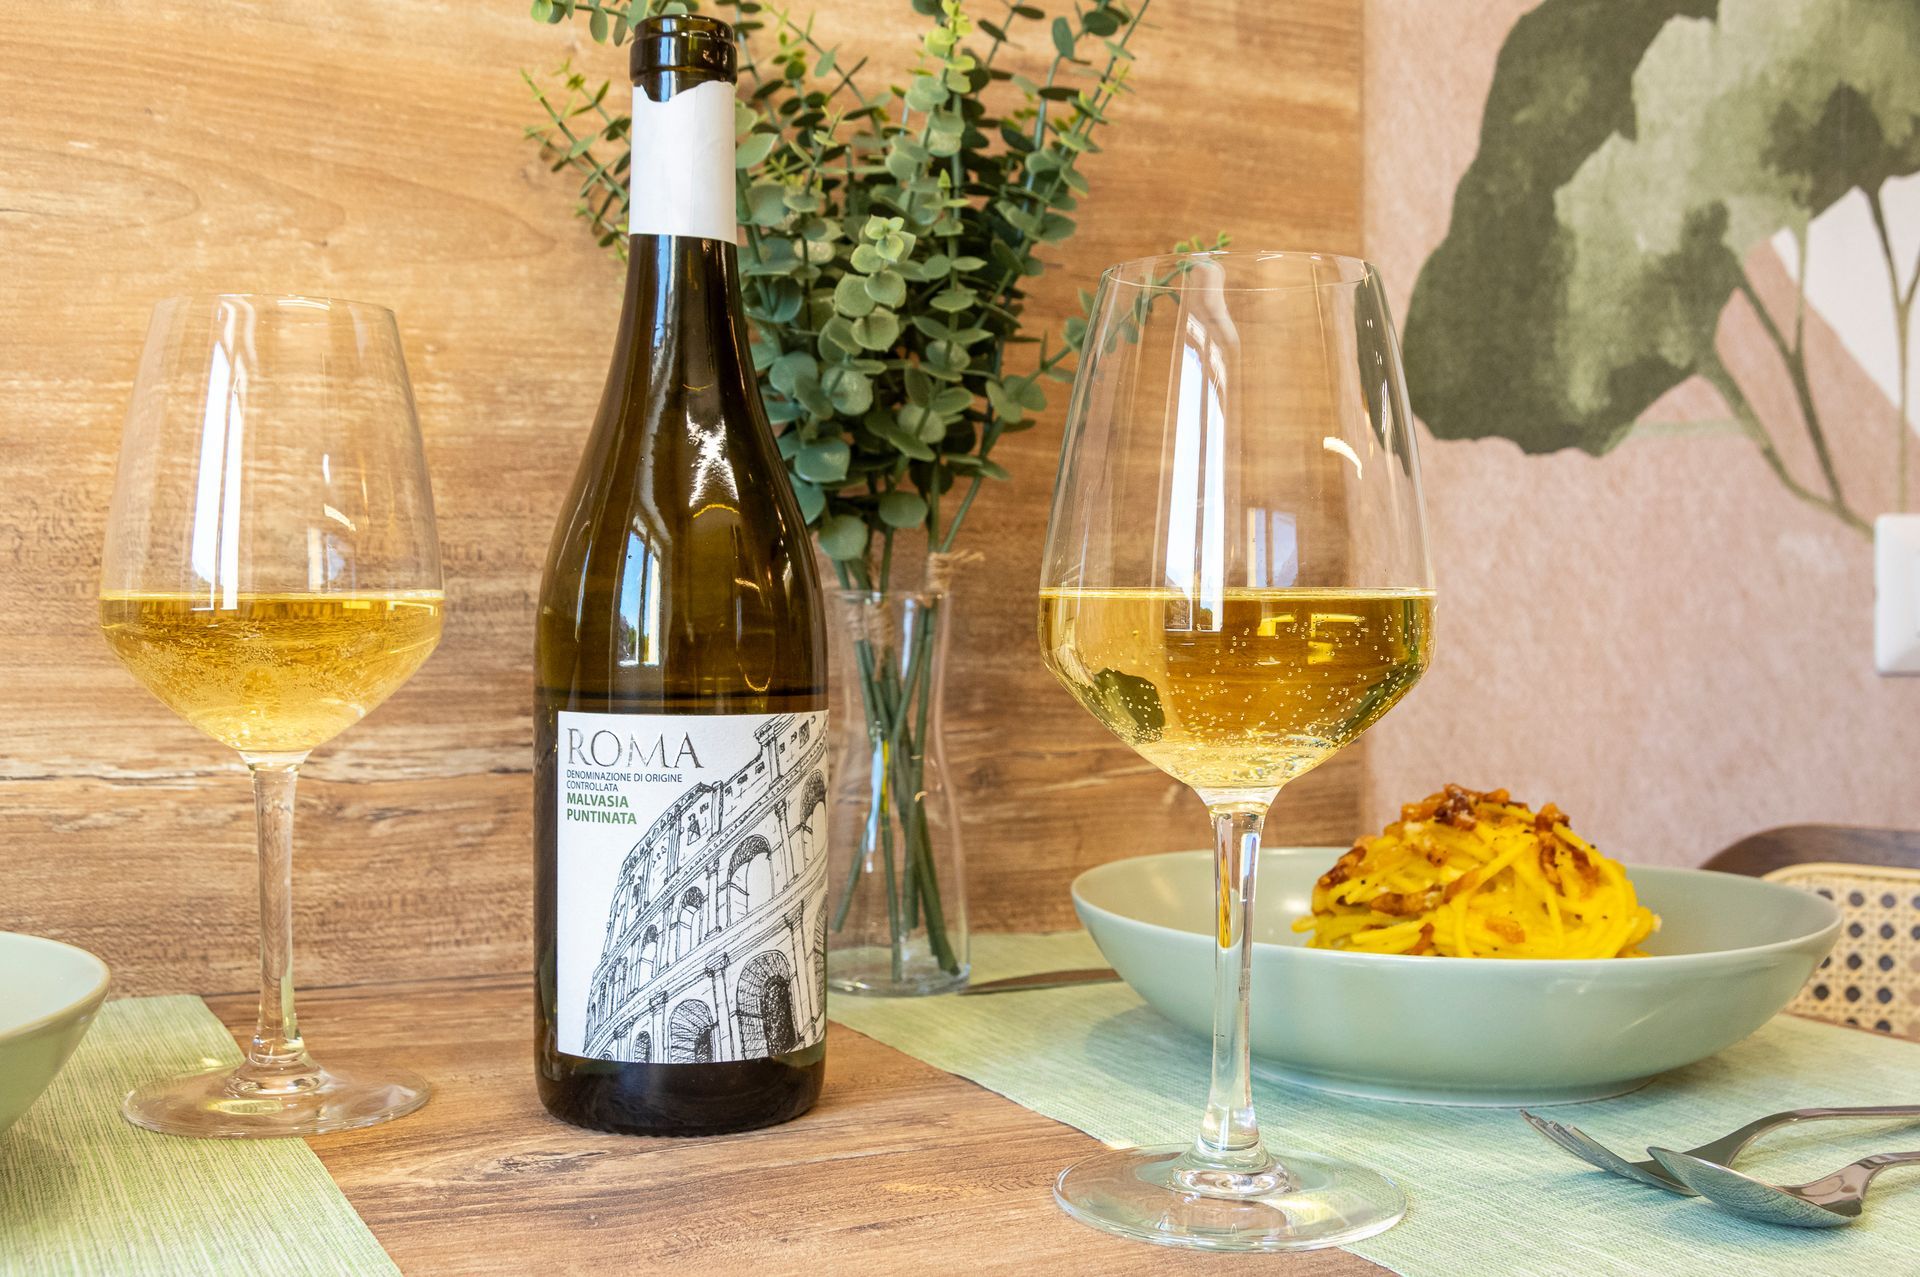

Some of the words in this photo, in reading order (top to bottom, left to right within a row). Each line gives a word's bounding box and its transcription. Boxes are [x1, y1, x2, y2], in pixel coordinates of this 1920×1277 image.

[567, 728, 704, 768] ROMA
[566, 769, 632, 782] DENOMINAZIONE
[633, 773, 643, 782] DI
[645, 773, 683, 783] ORIGINE
[566, 781, 619, 792] CONTROLLATA
[566, 792, 629, 808] MALVASIA
[566, 808, 637, 825] PUNTINATA
